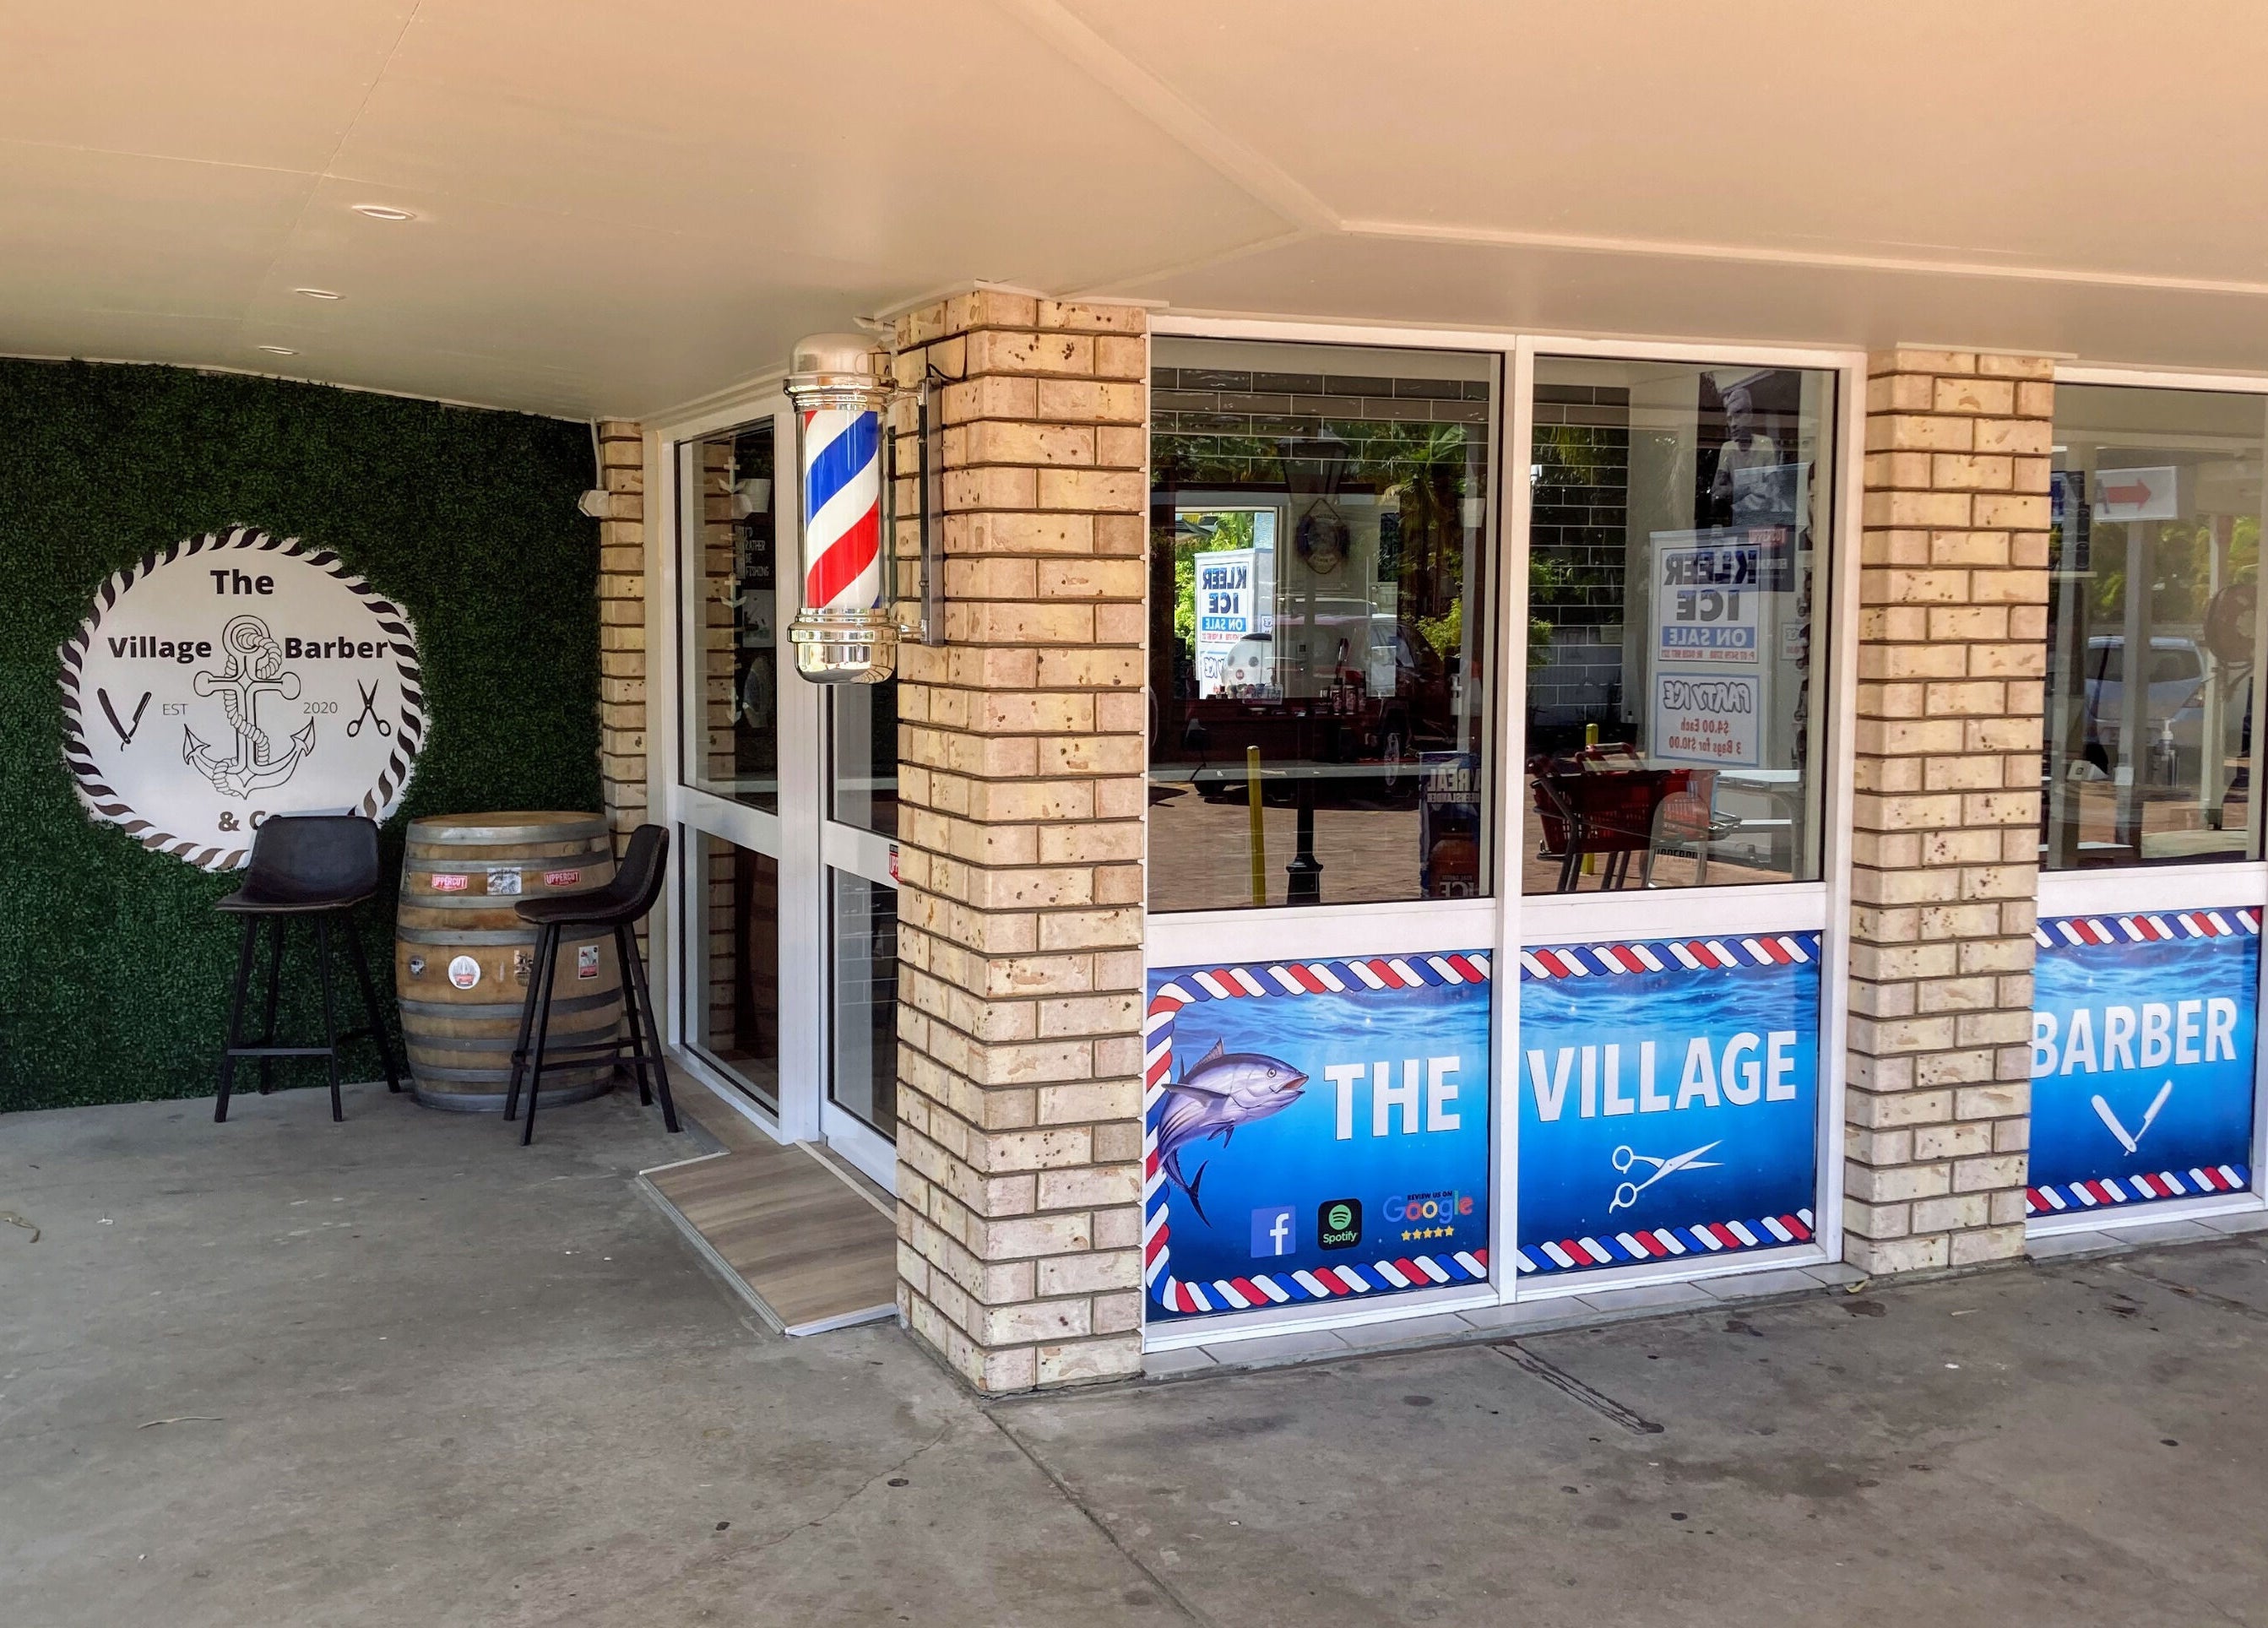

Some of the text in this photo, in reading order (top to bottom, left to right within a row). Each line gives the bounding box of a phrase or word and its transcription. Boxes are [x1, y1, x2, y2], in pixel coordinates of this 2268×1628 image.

[210, 568, 274, 595] The
[107, 636, 388, 664] Village Barber
[162, 703, 188, 716] EST
[302, 701, 338, 714] 2020
[218, 811, 241, 832] &
[433, 877, 465, 887] UPPERCUT
[545, 872, 578, 884] UPPERCUT
[2028, 997, 2237, 1079] BARBER
[1527, 1030, 1796, 1122] VILLAGE
[1324, 1055, 1460, 1141] THE
[1383, 1191, 1473, 1224] Google
[1322, 1231, 1357, 1245] Spotify
